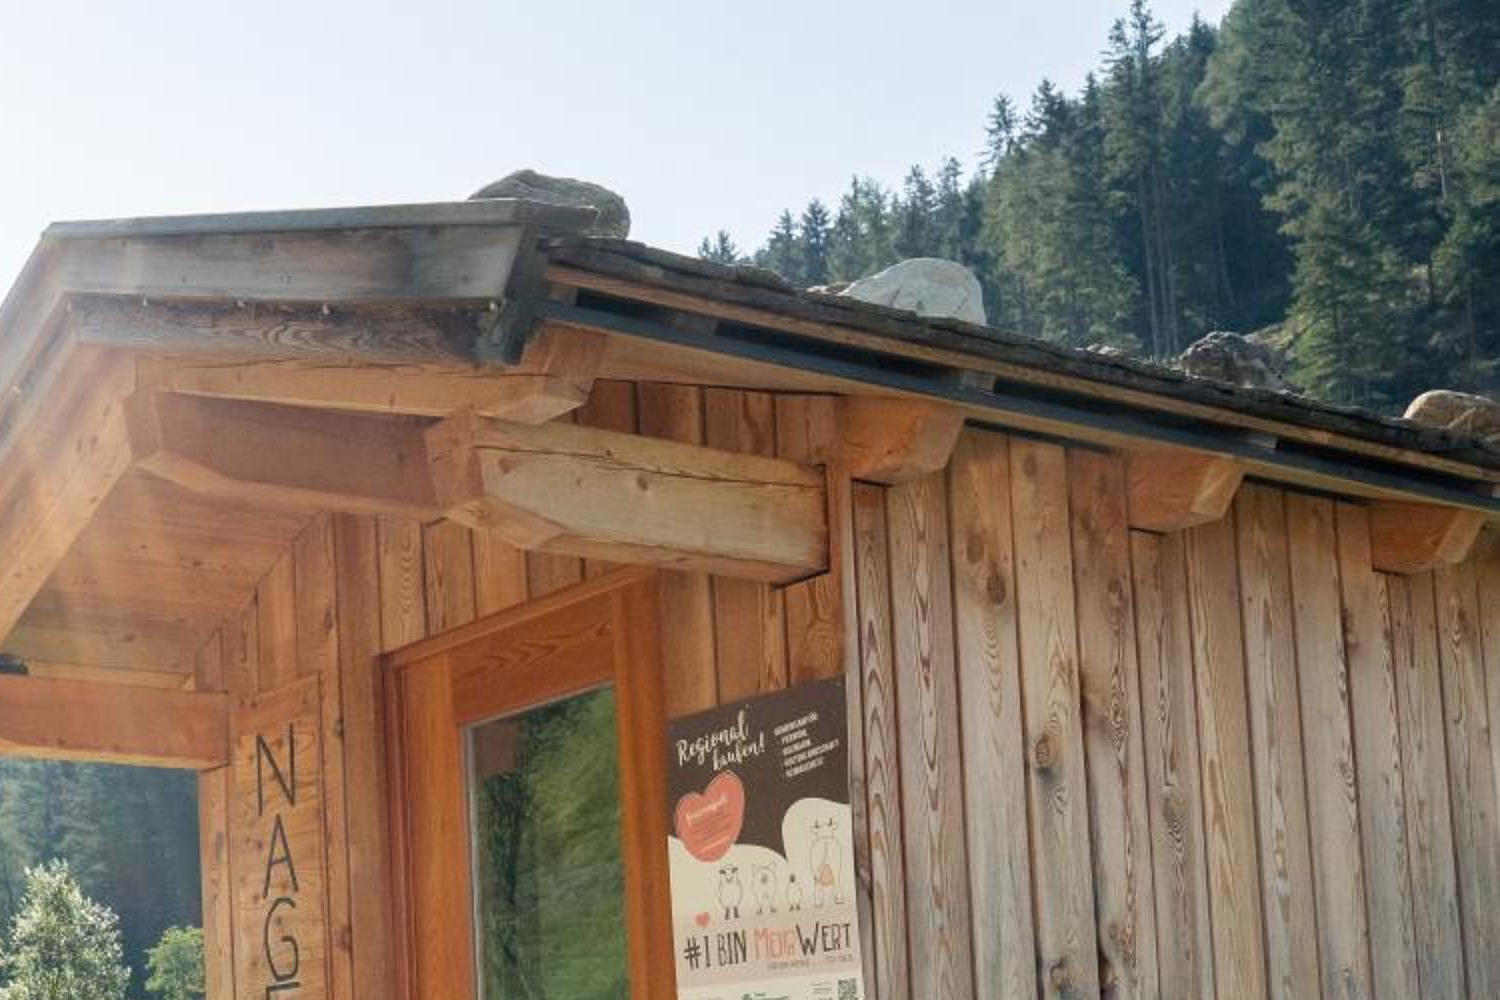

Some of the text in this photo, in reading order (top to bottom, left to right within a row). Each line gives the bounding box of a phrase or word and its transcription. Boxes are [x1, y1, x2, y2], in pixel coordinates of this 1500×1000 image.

[676, 708, 749, 767] Regional
[712, 730, 765, 771] kaufen!
[683, 935, 711, 970] #I
[716, 930, 748, 967] BIN
